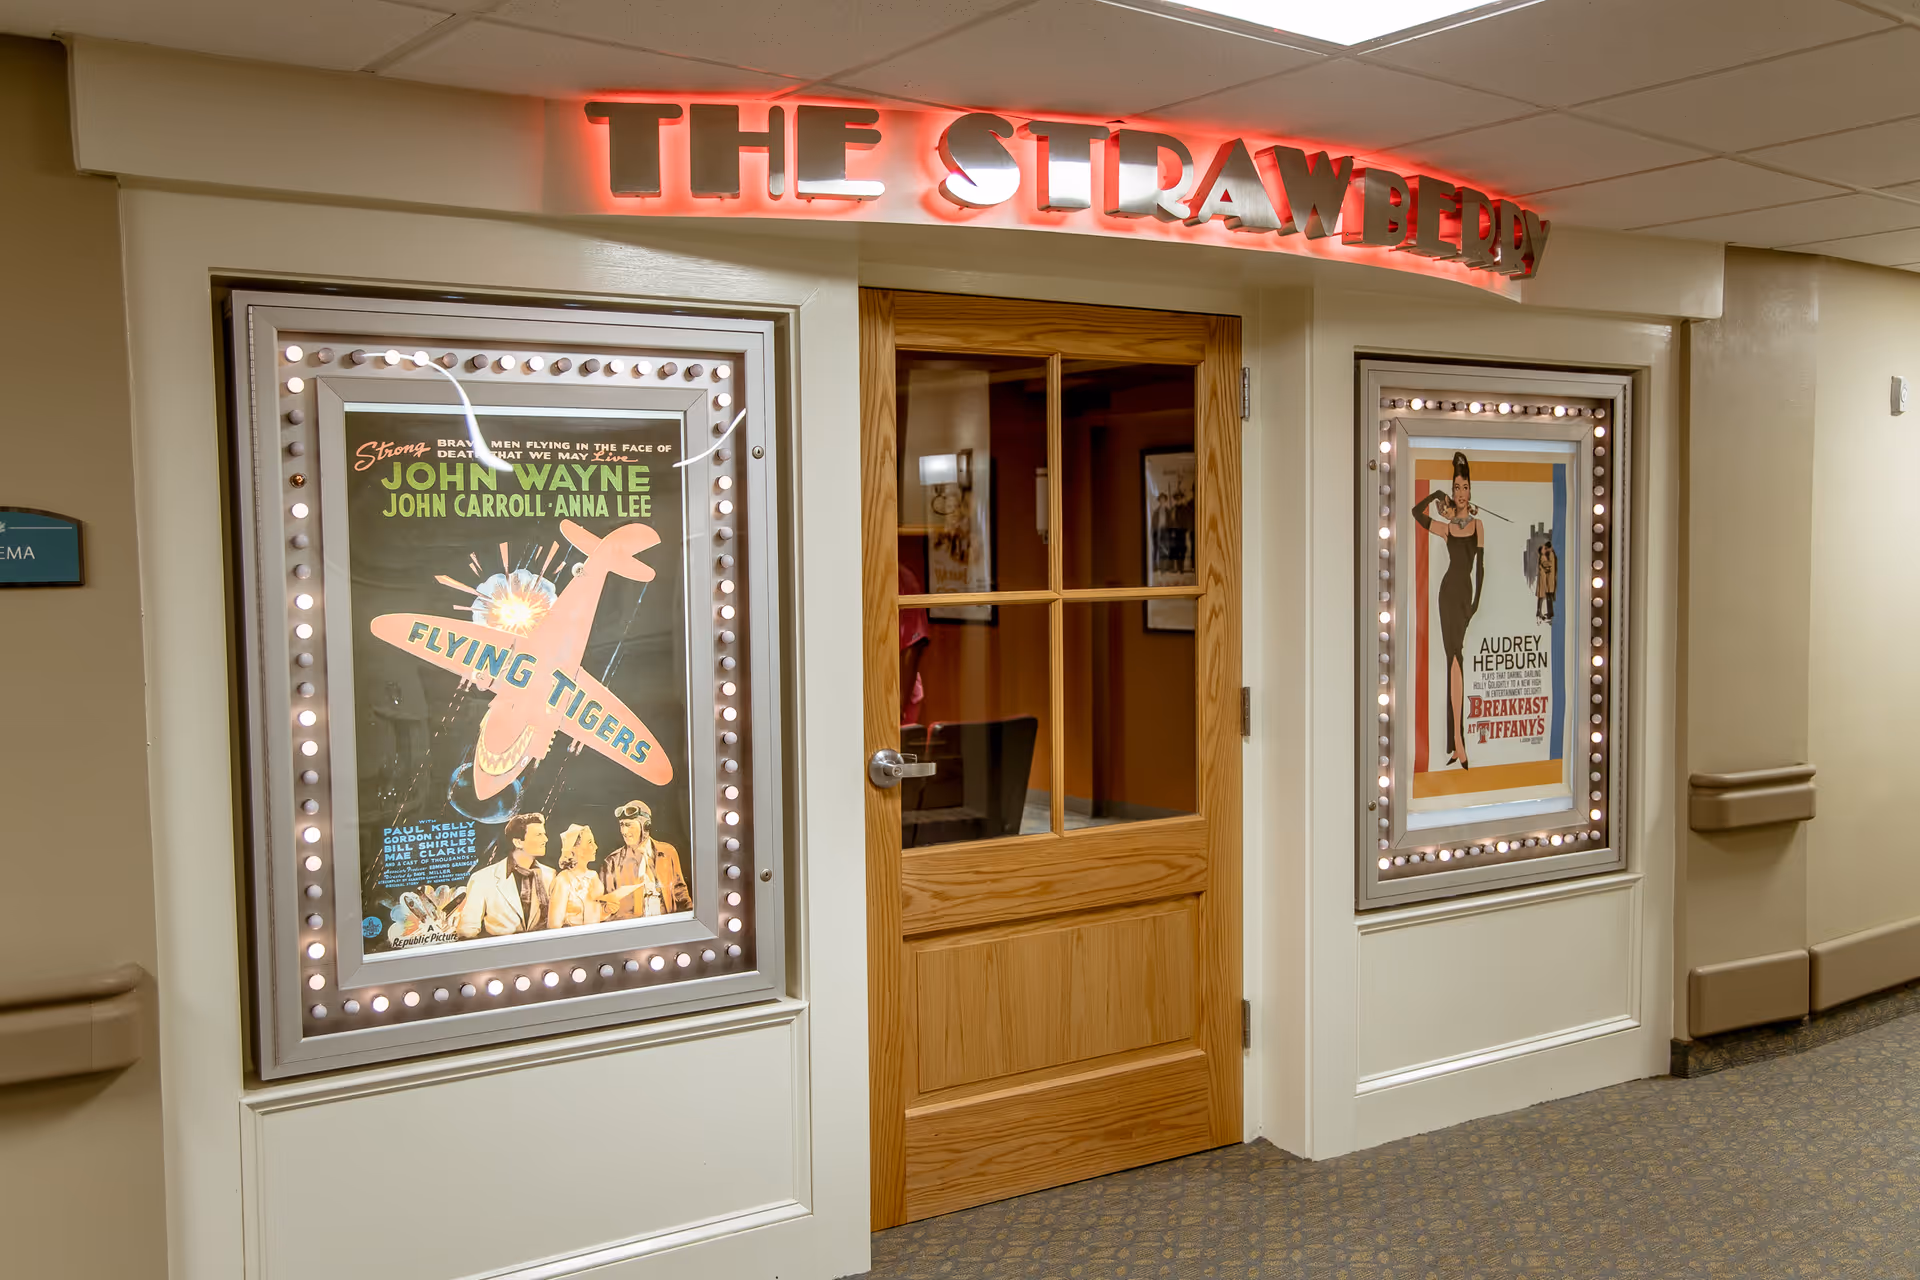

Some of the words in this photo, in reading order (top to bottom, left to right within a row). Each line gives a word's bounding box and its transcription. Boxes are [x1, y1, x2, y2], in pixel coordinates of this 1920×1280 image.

[584, 100, 886, 200] THE
[354, 441, 431, 472] Strong
[437, 439, 475, 448] BRAV
[491, 440, 520, 449] MEN
[526, 441, 570, 450] FLYING
[576, 442, 588, 450] IN
[594, 443, 617, 452] THE
[622, 444, 653, 452] FACE
[657, 445, 672, 453] OF
[437, 450, 475, 459] DEAT
[529, 451, 551, 460] WE
[558, 452, 588, 460] MAY
[591, 450, 638, 462] Live
[380, 461, 497, 491] JOHN
[512, 463, 650, 492] WAYNE
[382, 493, 446, 517] JOHN
[454, 493, 546, 518] CARROLL
[554, 494, 609, 517] ANNA
[617, 494, 651, 517] LEE
[407, 620, 538, 689] FLYING
[1479, 635, 1542, 654] AUDREY
[1473, 652, 1548, 672] HEPBURN
[1482, 672, 1495, 680] PLAYS
[1496, 672, 1506, 680] THAT
[546, 668, 652, 765] TIGERS
[1467, 695, 1548, 719] BREAKFAST
[1467, 723, 1476, 734] AT
[1477, 715, 1545, 744] TIFFANY'S
[384, 826, 424, 836] PAUL
[432, 821, 476, 832] KELLY
[384, 834, 432, 844] GORDON
[435, 830, 476, 840] JONES
[384, 844, 413, 853] BILL
[418, 837, 476, 850] SHIRLEY
[385, 852, 411, 861] MAE
[420, 846, 476, 858] CLARKE
